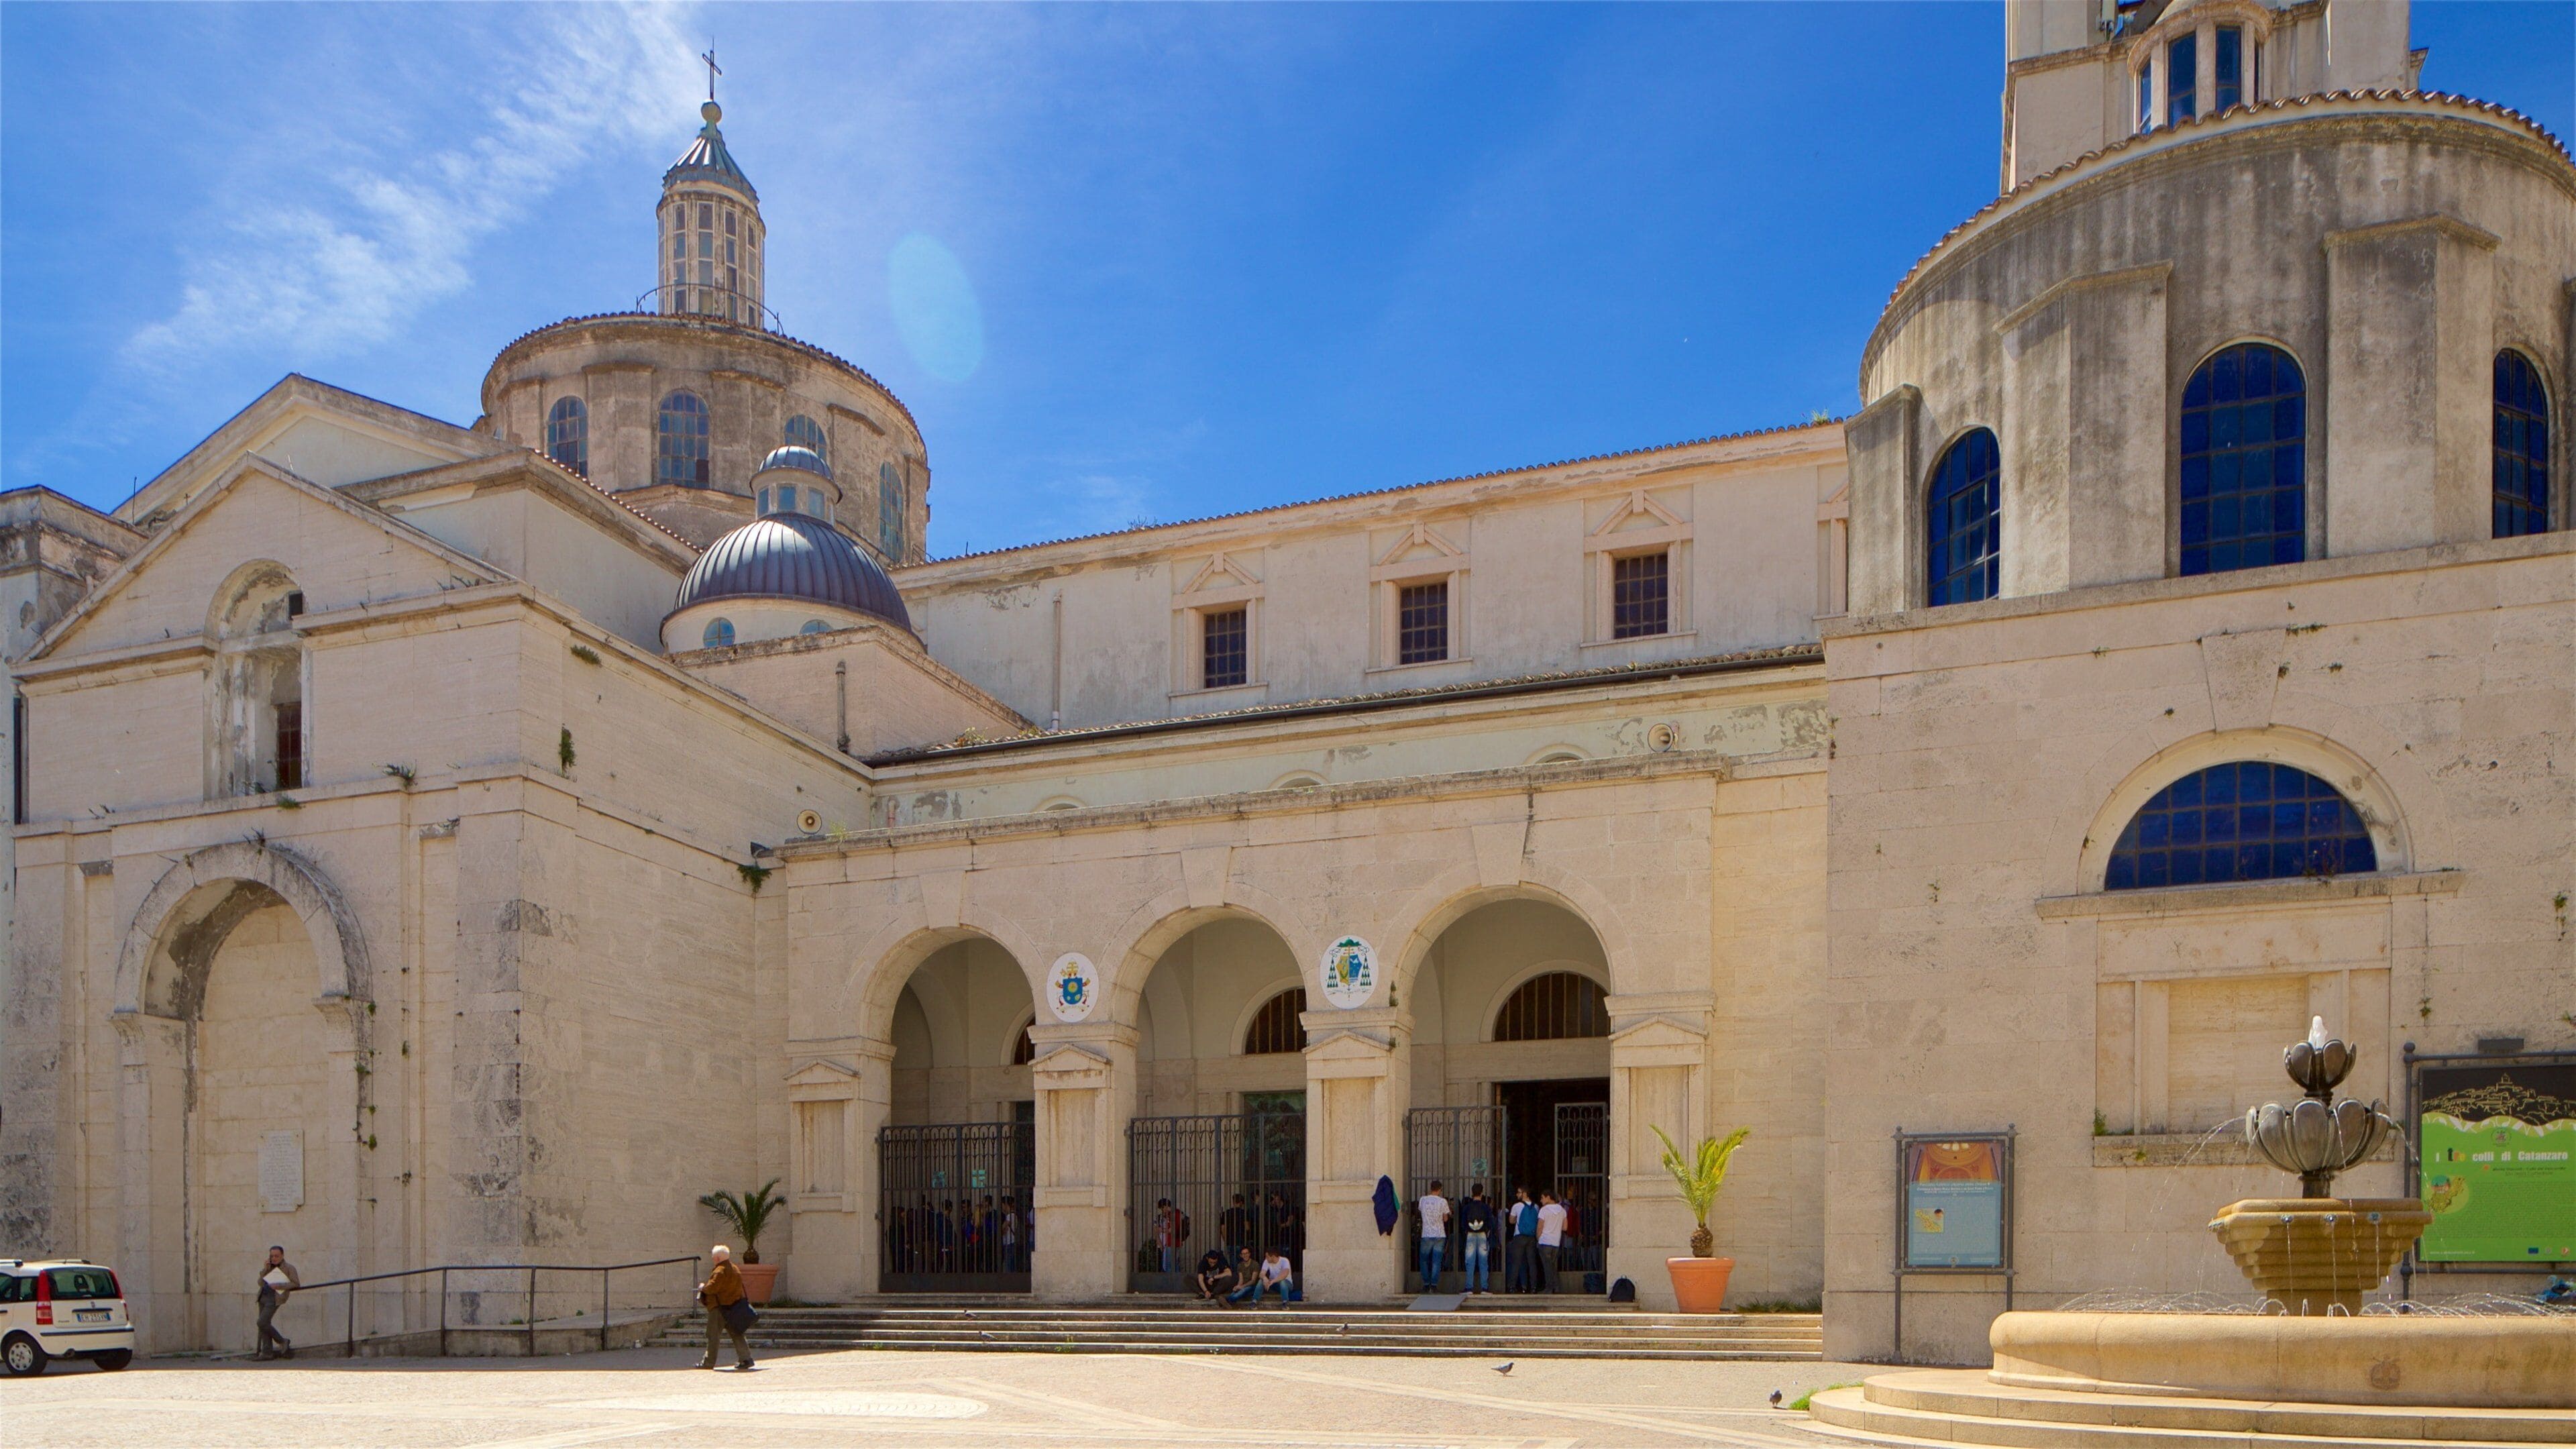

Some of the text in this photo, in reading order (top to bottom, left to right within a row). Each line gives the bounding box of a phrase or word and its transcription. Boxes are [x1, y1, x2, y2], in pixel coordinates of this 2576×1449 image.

[2447, 1148, 2466, 1162] tre
[2472, 1151, 2494, 1162] colli
[2501, 1150, 2511, 1161] di
[2518, 1150, 2568, 1161] Catanzaro
